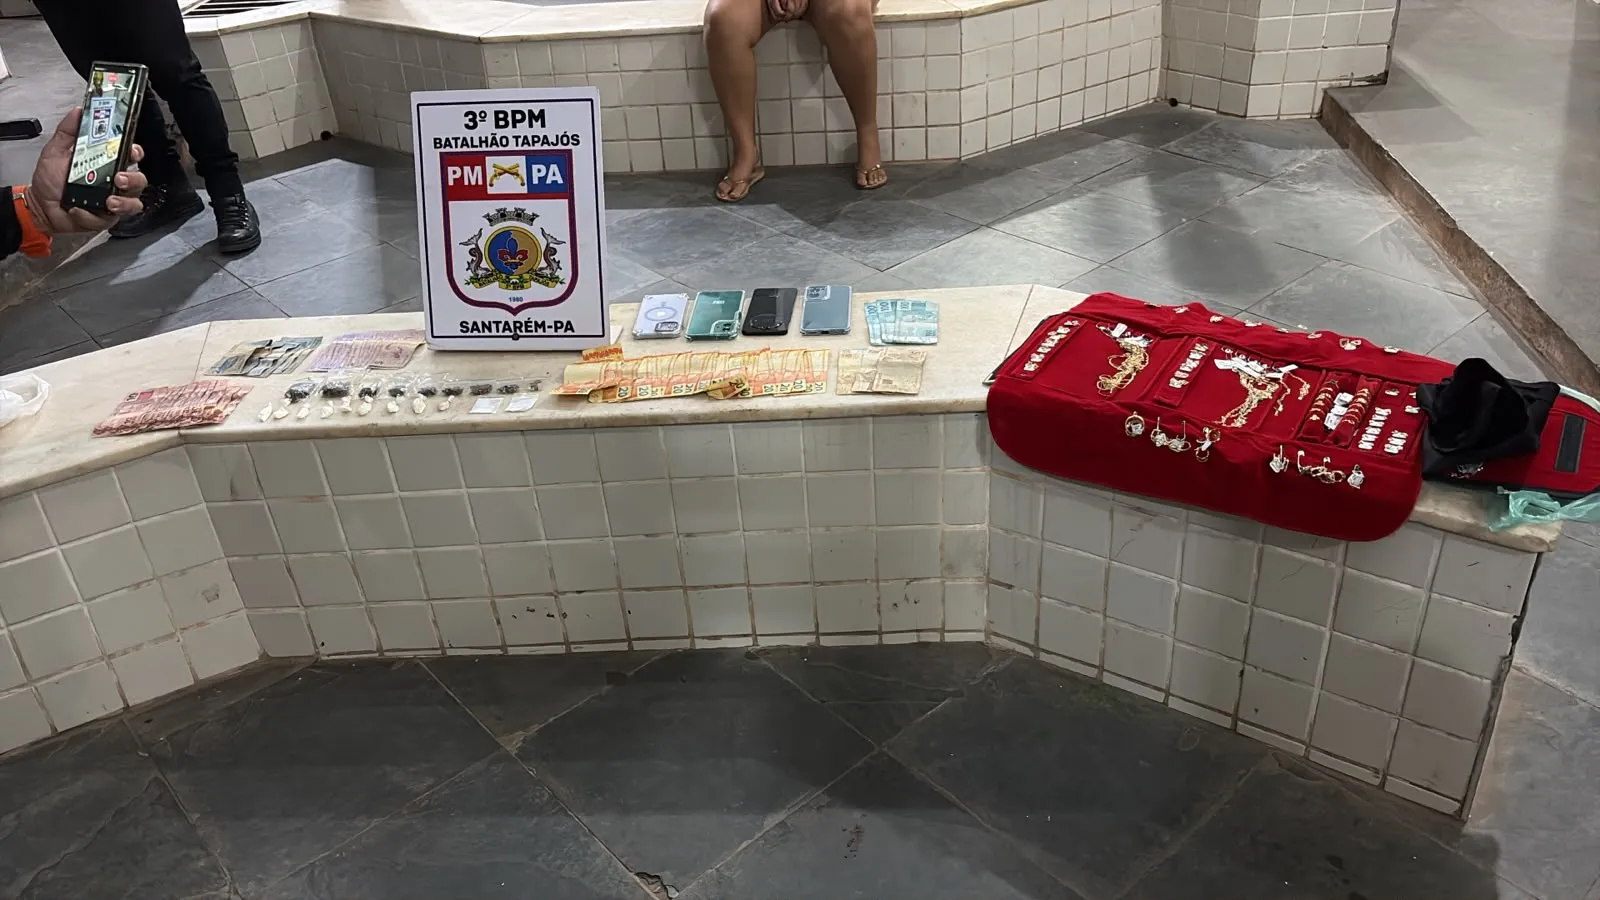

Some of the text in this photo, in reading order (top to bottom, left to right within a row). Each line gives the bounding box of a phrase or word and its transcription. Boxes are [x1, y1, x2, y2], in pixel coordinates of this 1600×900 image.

[463, 108, 546, 130] 3º BPM
[433, 131, 580, 150] BATALHÃO TAPAJÓS
[447, 166, 483, 186] PM
[531, 164, 564, 184] PA
[459, 317, 575, 334] SANTARÉM-PA
[617, 386, 629, 397] 20
[638, 386, 649, 396] 20
